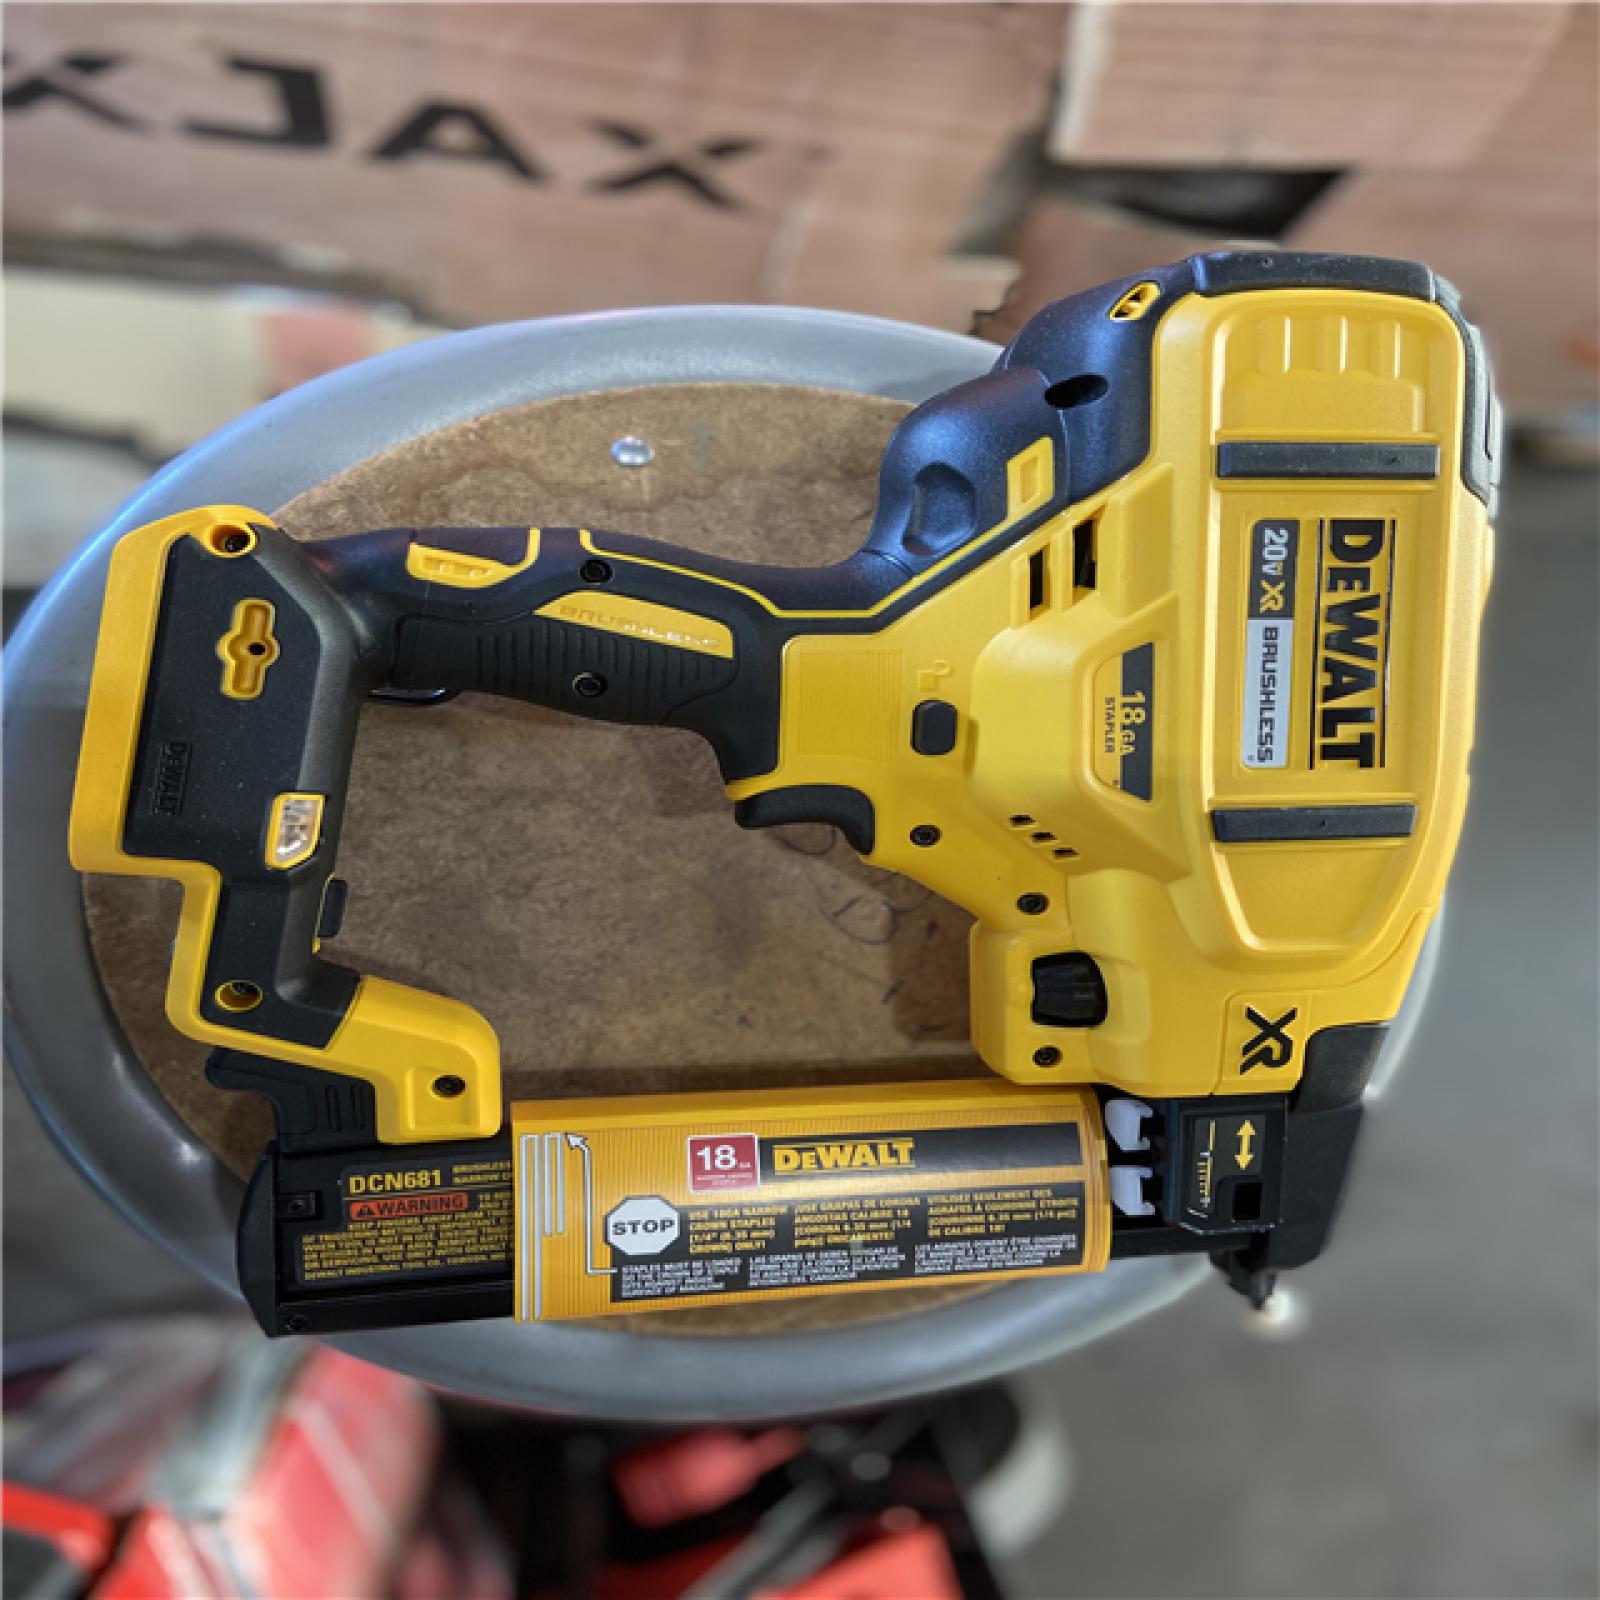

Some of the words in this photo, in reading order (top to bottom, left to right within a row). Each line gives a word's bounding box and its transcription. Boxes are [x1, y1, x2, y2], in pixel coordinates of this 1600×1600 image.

[1259, 579, 1286, 614] XR
[1319, 518, 1386, 769] DEWALT
[1257, 626, 1280, 764] BRUSHLESS
[1104, 696, 1116, 754] STAPLER
[1240, 1006, 1298, 1075] XR
[696, 1144, 736, 1171] 18
[773, 1138, 916, 1173] DEWALT
[350, 1169, 441, 1194] DCN681
[376, 1194, 464, 1216] WARNING
[611, 1219, 675, 1236] STOP
